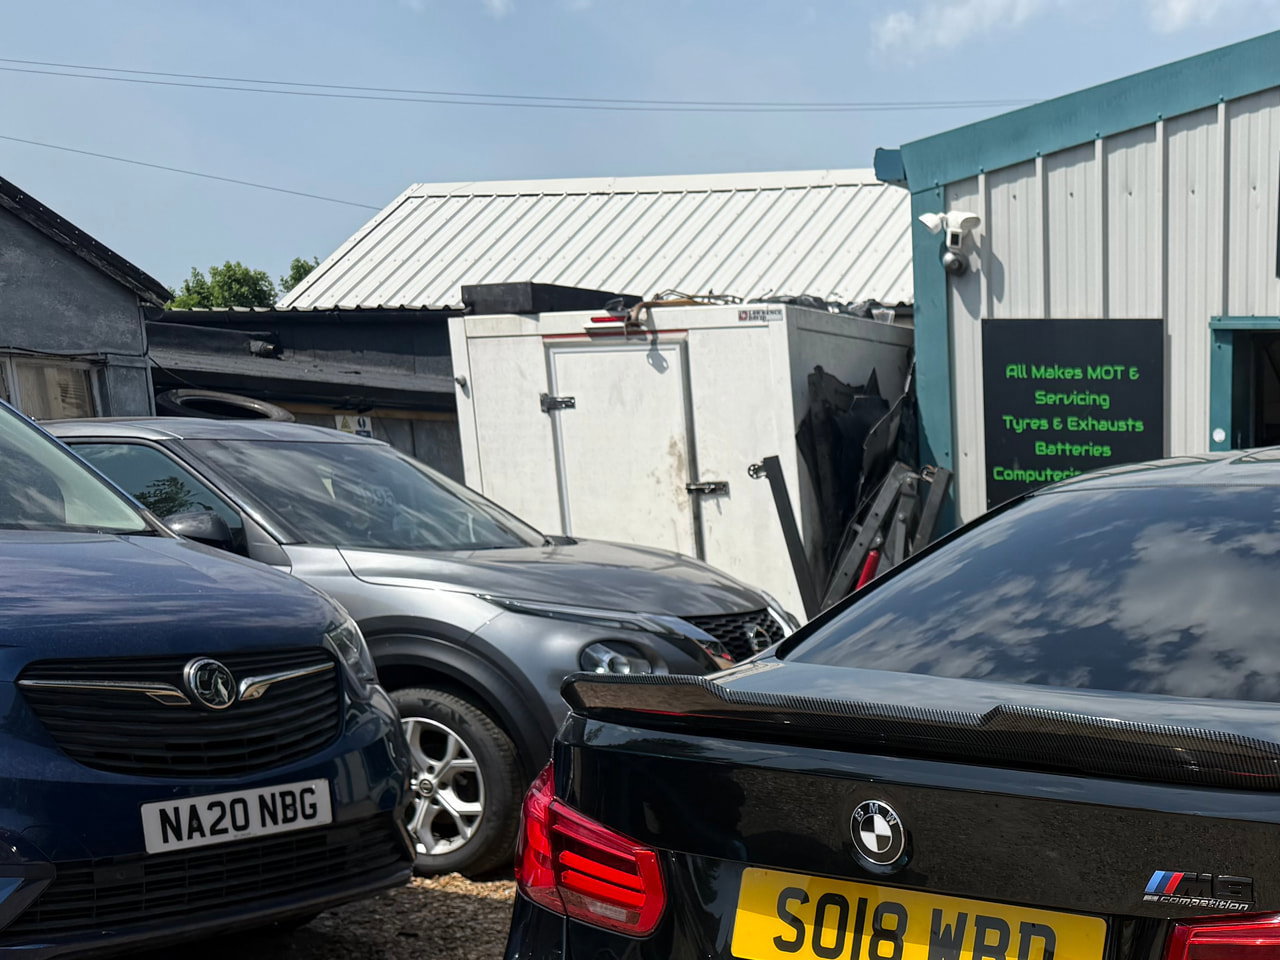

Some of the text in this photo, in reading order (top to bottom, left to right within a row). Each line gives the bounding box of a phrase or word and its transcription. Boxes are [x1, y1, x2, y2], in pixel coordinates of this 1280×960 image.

[1005, 364, 1140, 380] All Makes MOT &
[1034, 390, 1111, 410] Servicing
[1002, 415, 1144, 433] Tyres & Exhausts
[1034, 441, 1112, 457] Batteries
[158, 786, 318, 844] NA20 NBG
[854, 802, 898, 826] BMW
[1159, 895, 1249, 911] competition
